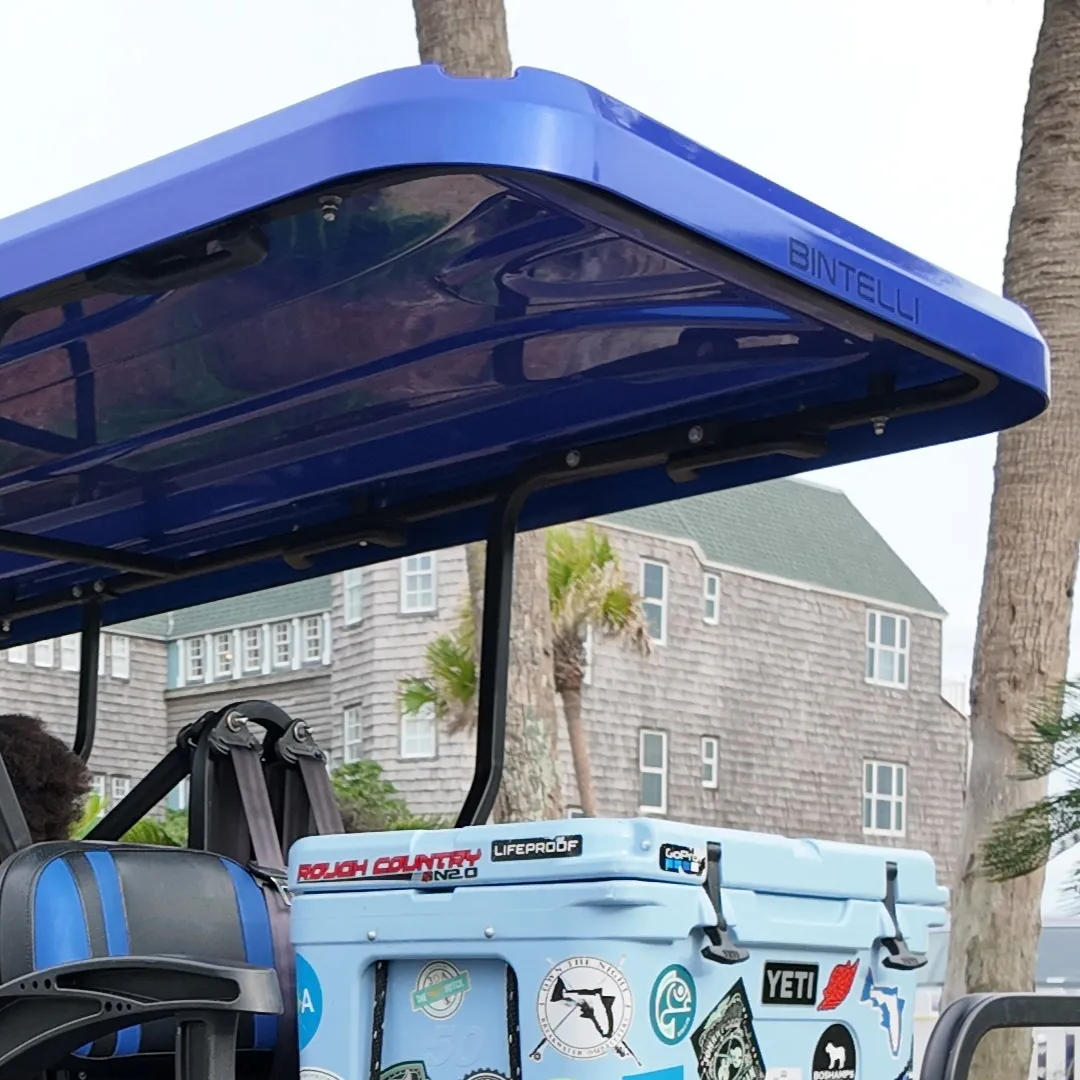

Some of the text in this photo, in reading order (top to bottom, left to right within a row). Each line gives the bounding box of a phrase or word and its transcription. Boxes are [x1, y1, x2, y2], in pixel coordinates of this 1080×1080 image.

[789, 236, 919, 325] BINTELLI
[494, 838, 579, 858] LIFEPROOF
[297, 848, 482, 882] ROUGH COUNTRY
[766, 969, 815, 1000] YETI
